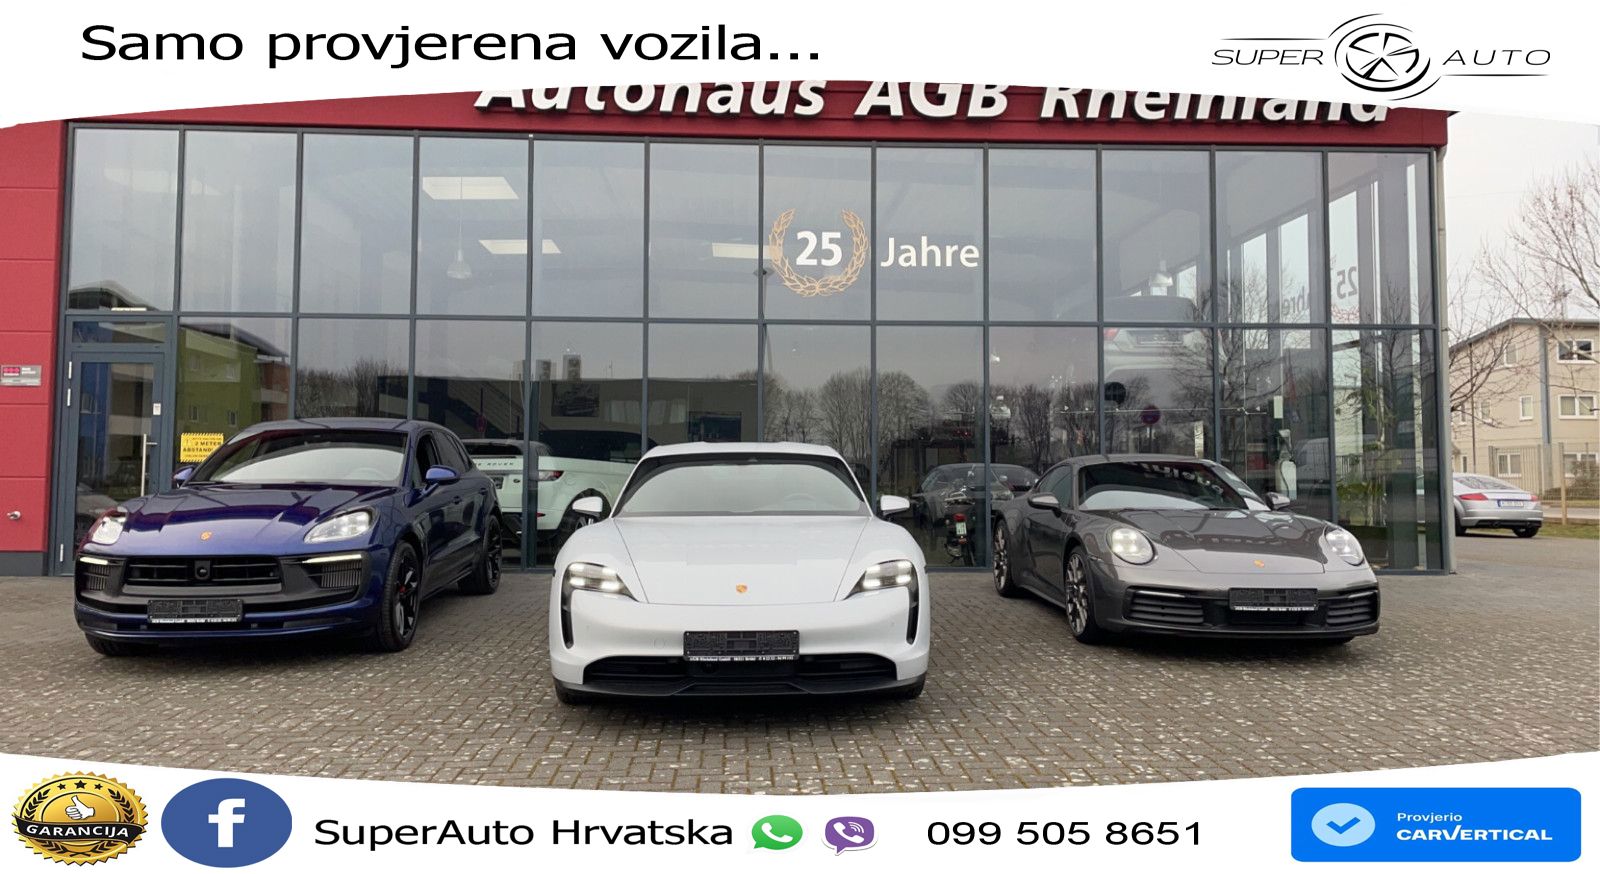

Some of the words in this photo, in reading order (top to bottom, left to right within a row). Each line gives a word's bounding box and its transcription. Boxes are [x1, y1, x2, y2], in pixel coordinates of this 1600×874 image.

[853, 81, 1009, 119] AGB
[796, 230, 843, 267] 25
[880, 235, 980, 268] Jahre
